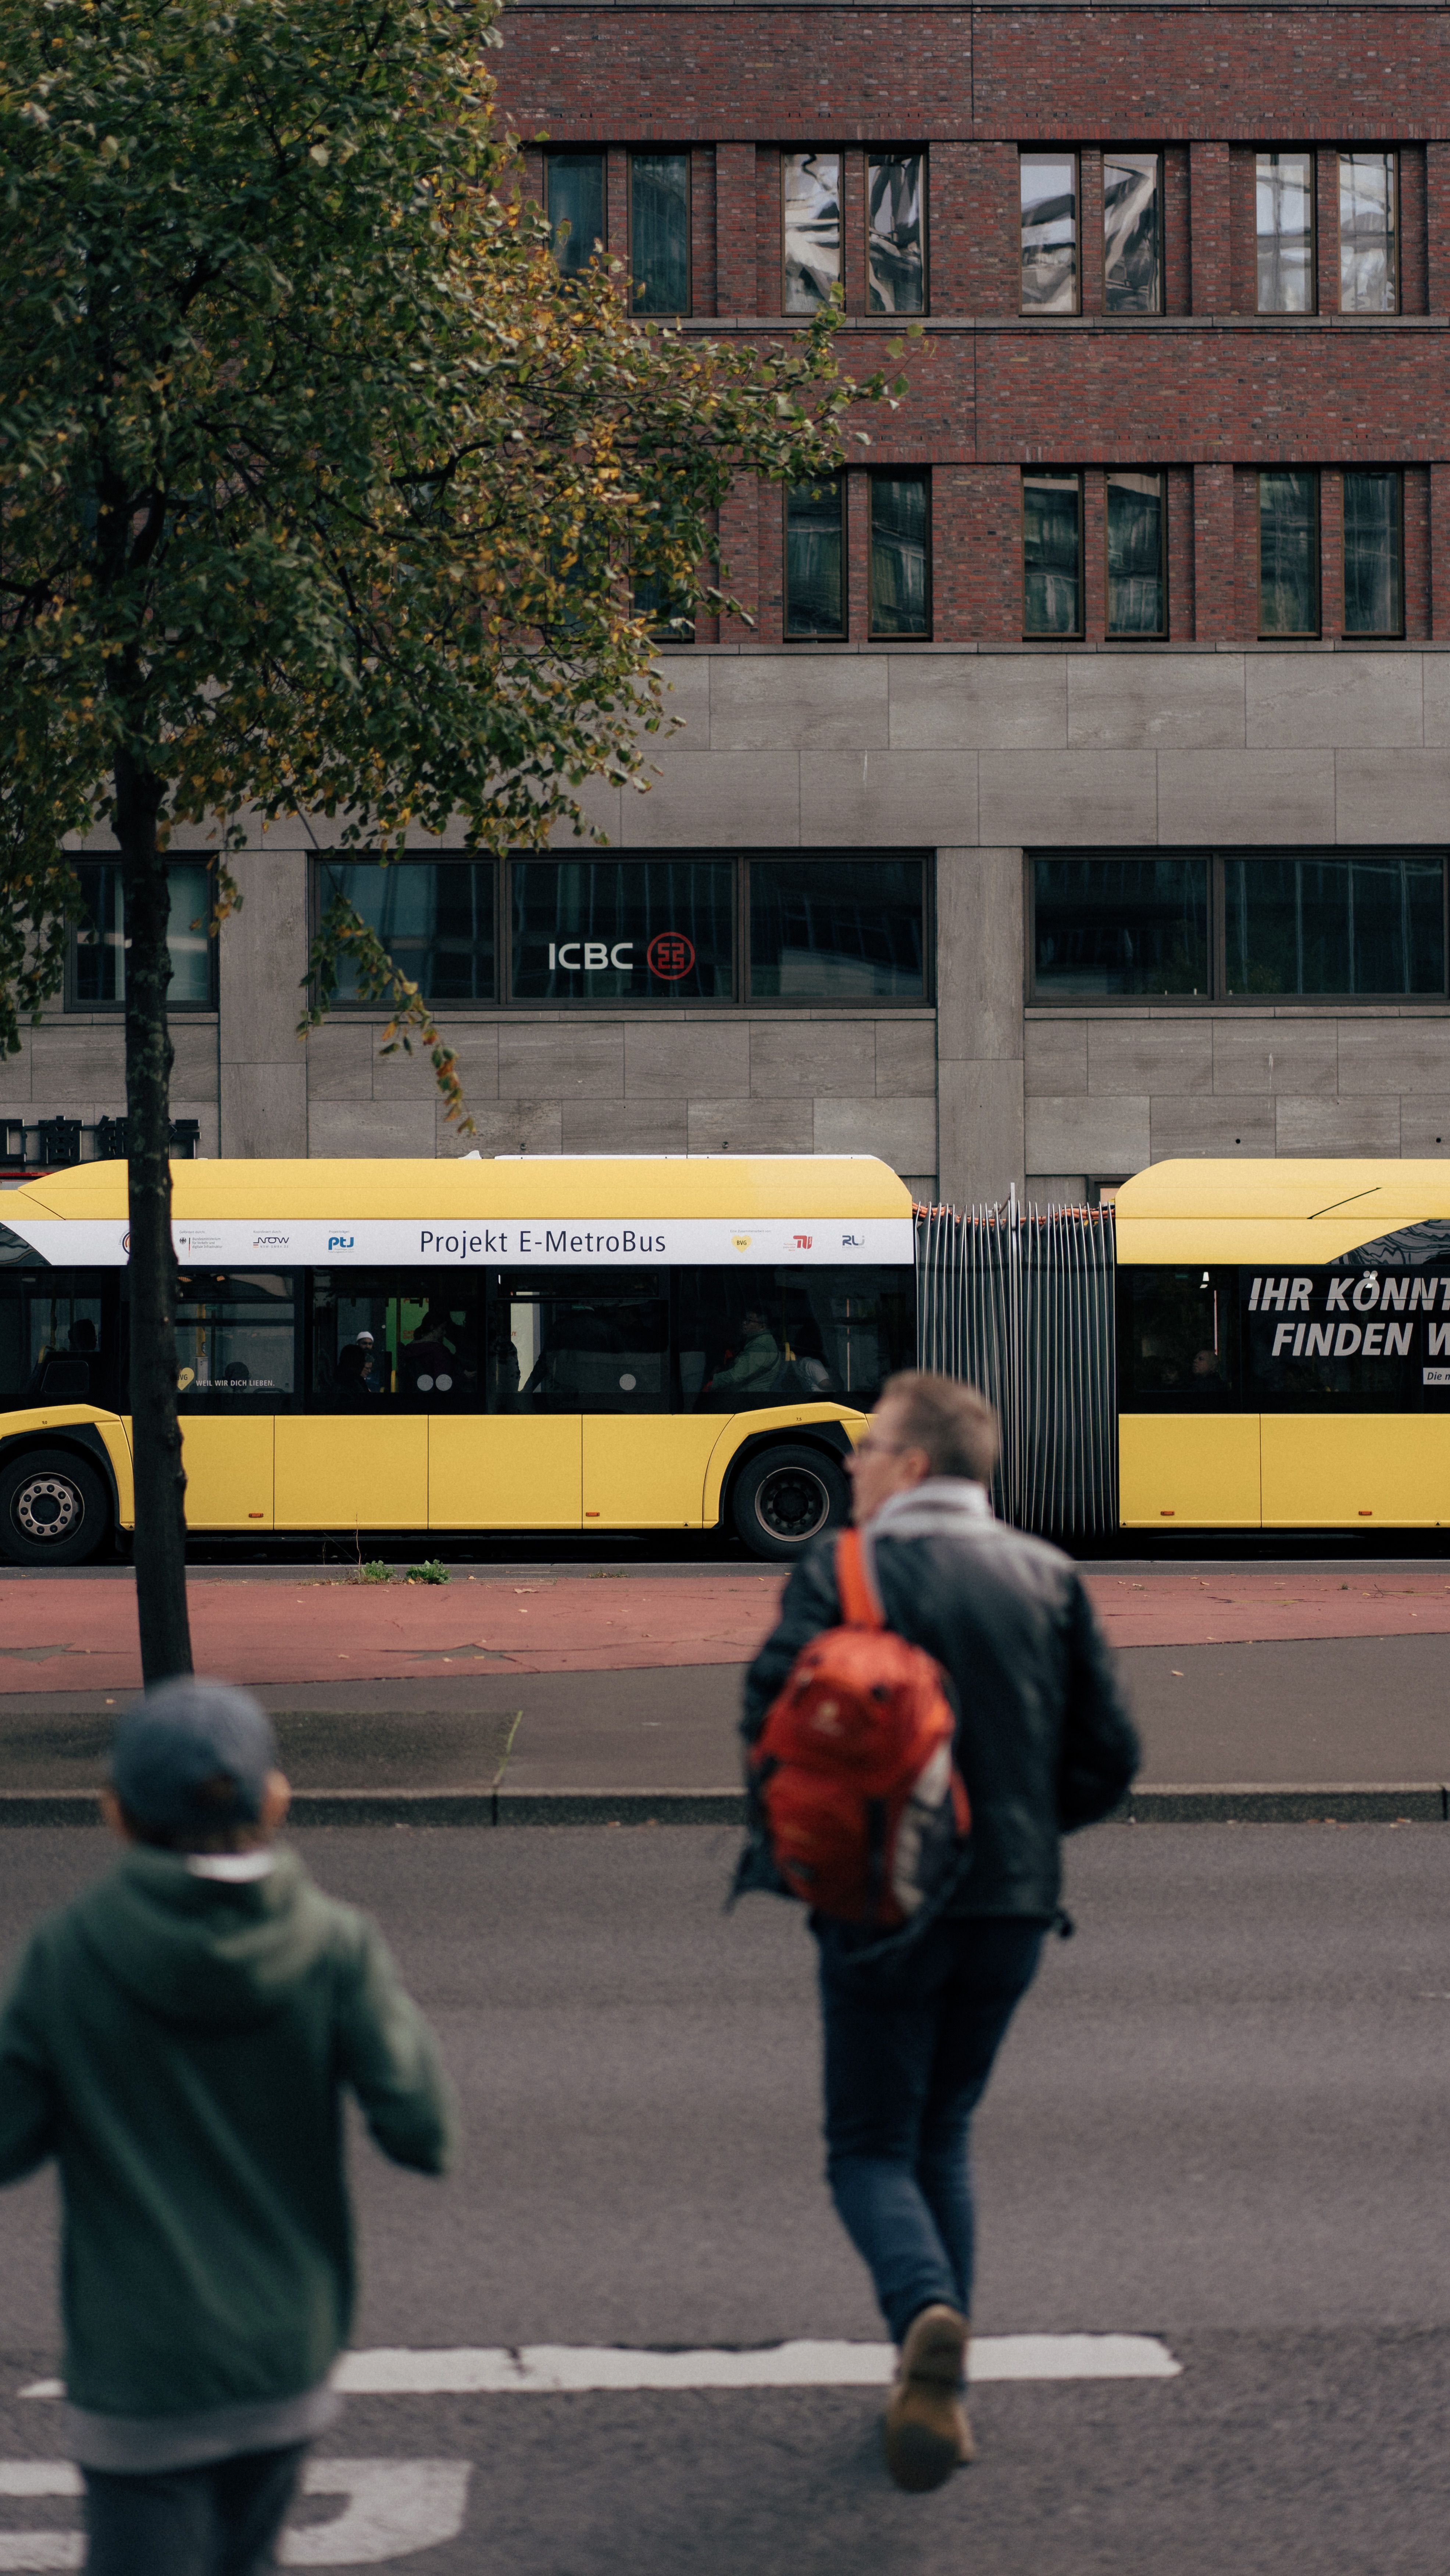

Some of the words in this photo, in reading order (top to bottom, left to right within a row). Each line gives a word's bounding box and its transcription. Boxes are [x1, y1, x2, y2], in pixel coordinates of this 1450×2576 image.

[549, 942, 633, 970] ICBC
[421, 1229, 508, 1259] Projekt
[519, 1230, 666, 1252] E-MetroBus
[1248, 1277, 1313, 1311] IHR
[1272, 1323, 1413, 1356] FINDEN
[1427, 1372, 1442, 1380] Die
